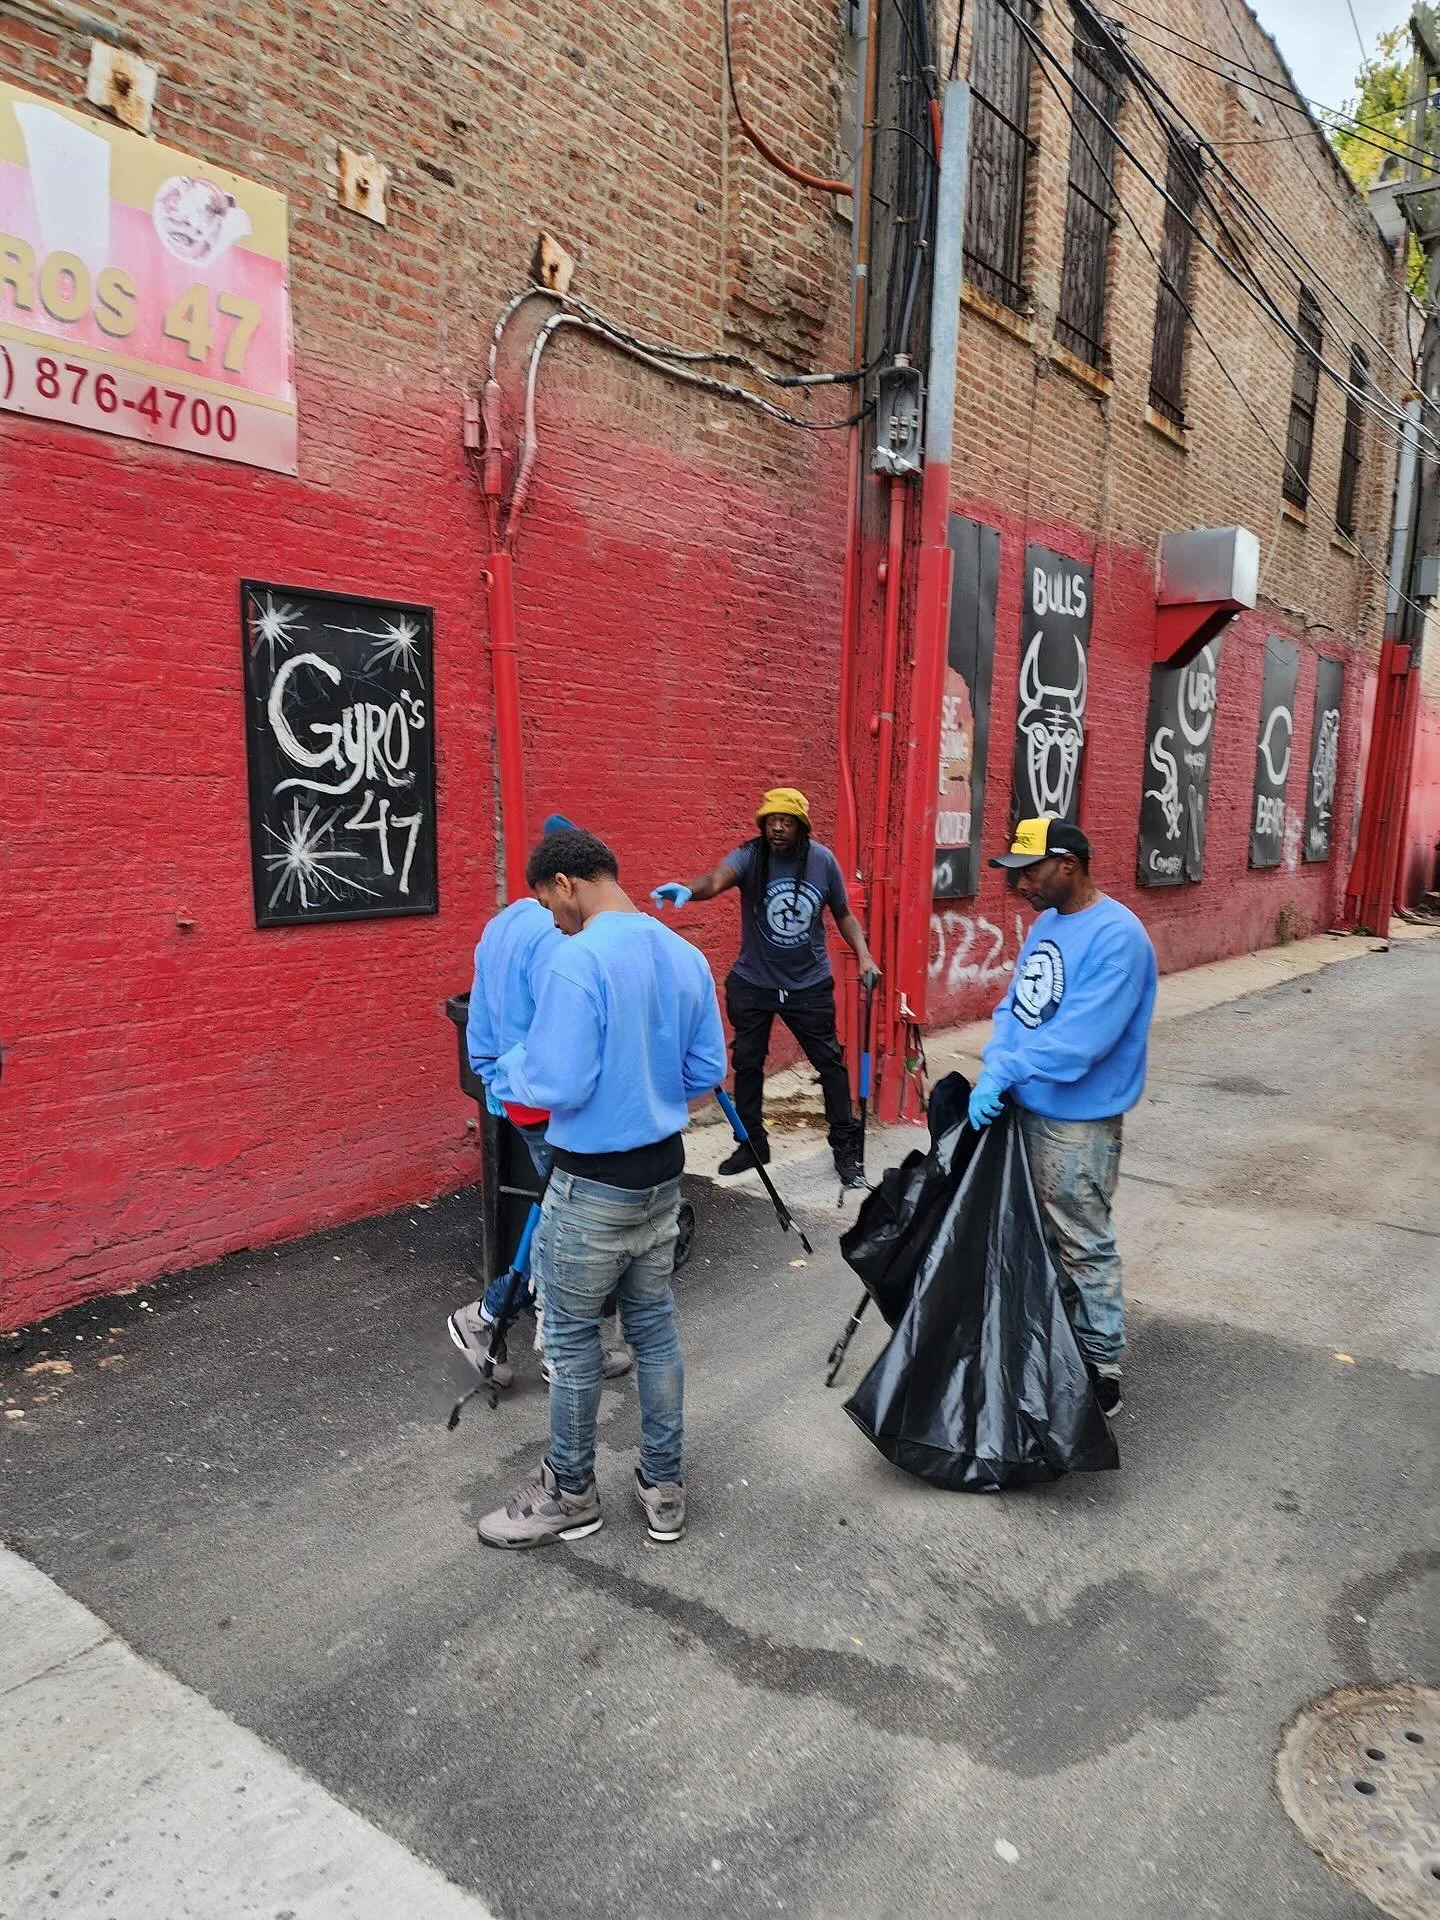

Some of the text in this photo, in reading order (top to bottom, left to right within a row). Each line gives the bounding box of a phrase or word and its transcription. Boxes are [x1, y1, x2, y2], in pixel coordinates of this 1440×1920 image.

[163, 282, 262, 374] 47
[36, 356, 237, 443] 876-4700
[1033, 567, 1087, 619] BULLS
[343, 789, 424, 895] 47
